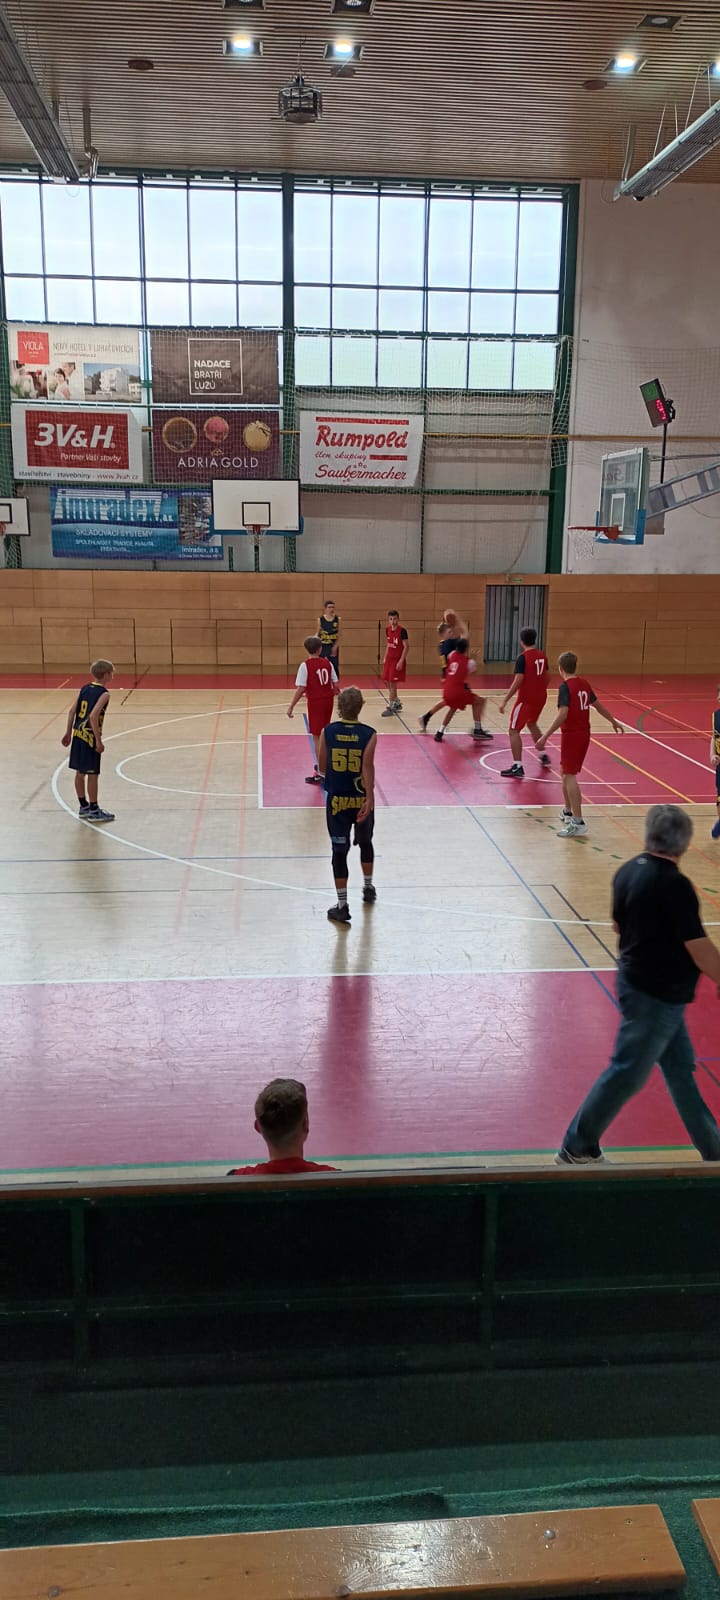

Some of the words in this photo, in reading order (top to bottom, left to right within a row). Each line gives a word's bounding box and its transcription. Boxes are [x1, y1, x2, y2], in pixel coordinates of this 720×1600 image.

[22, 341, 44, 351] VIOLA
[69, 343, 86, 352] HOTEL
[194, 360, 231, 368] NADACE
[194, 370, 222, 378] BRATŘÍ
[315, 424, 409, 451] Rumpold
[60, 452, 84, 461] Partner
[100, 454, 121, 464] stavby
[177, 457, 218, 468] ADRIA
[221, 457, 259, 468] GOLD
[315, 464, 407, 480] Saubermacher
[534, 658, 545, 676] 17
[316, 668, 329, 686] 10
[577, 690, 589, 711] 12
[78, 700, 88, 719] 9
[331, 747, 363, 773] 55
